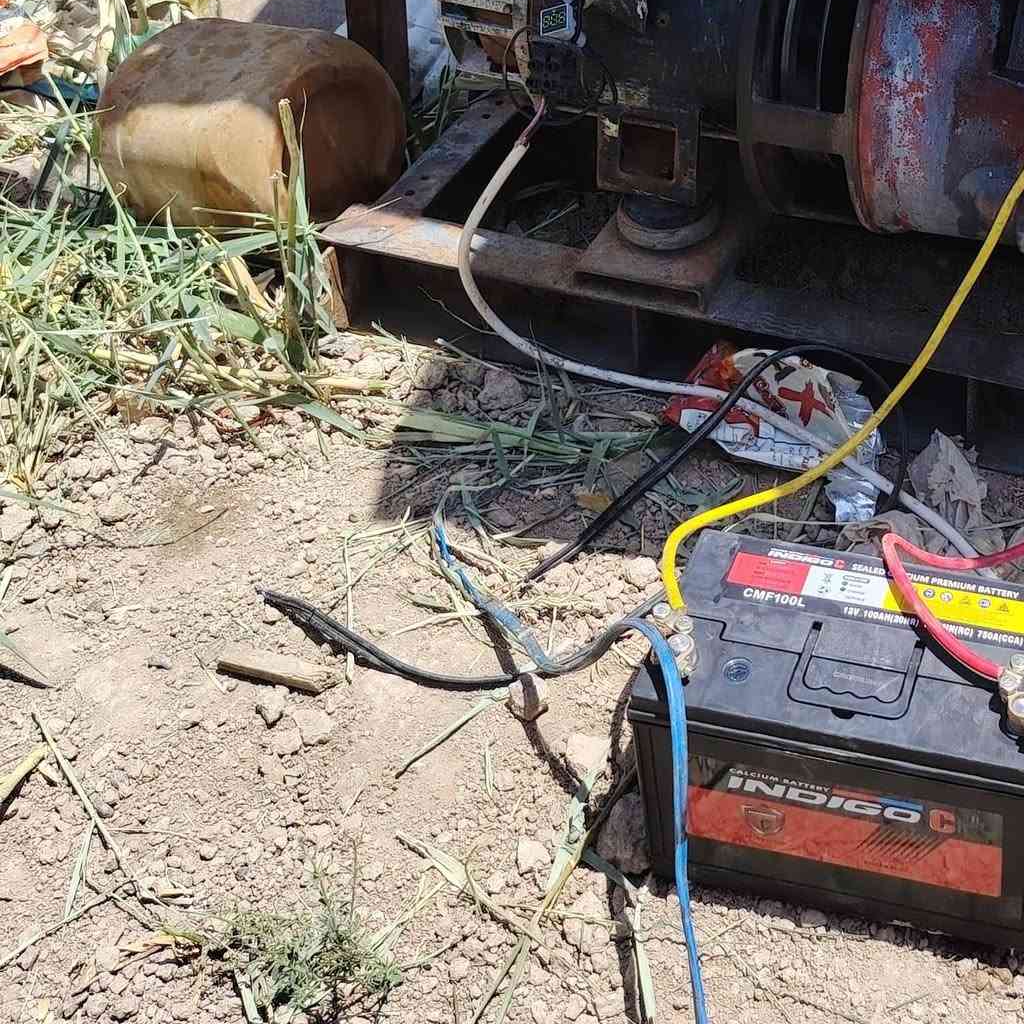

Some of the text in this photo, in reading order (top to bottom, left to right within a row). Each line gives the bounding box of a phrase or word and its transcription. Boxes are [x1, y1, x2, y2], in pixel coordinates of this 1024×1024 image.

[767, 549, 834, 567] INDIGO
[852, 563, 886, 576] SEALED
[930, 576, 976, 592] PREMIUM
[977, 585, 1020, 599] BATTERY
[743, 587, 806, 608] CMF100L
[843, 606, 859, 618] 12V
[976, 628, 1024, 646] 750A(CCA)
[729, 767, 832, 793] CALCIUM BATTERY
[727, 775, 922, 824] INDIGO
